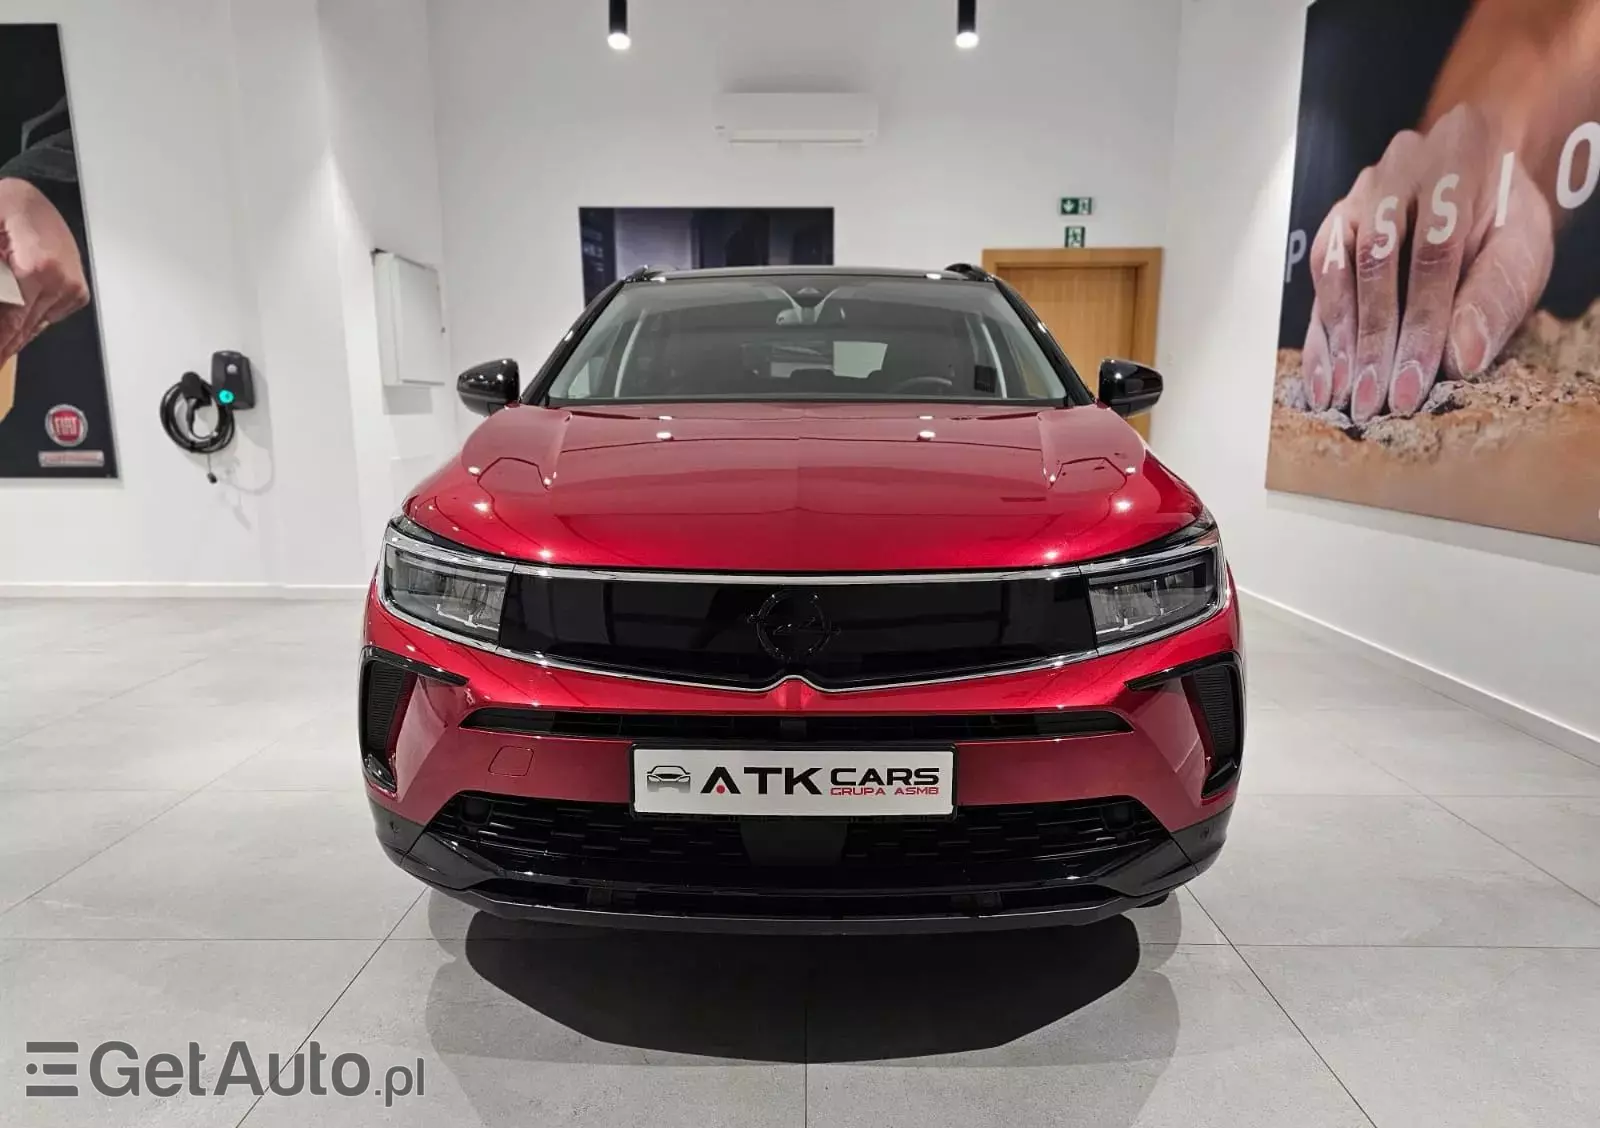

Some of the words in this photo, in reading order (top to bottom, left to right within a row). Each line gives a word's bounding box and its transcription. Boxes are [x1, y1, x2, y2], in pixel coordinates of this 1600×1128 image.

[1285, 121, 1600, 283] PASSIO
[700, 766, 823, 795] ATK
[830, 767, 940, 786] CARS
[830, 787, 886, 796] GRUPA
[894, 786, 940, 795] ASMB
